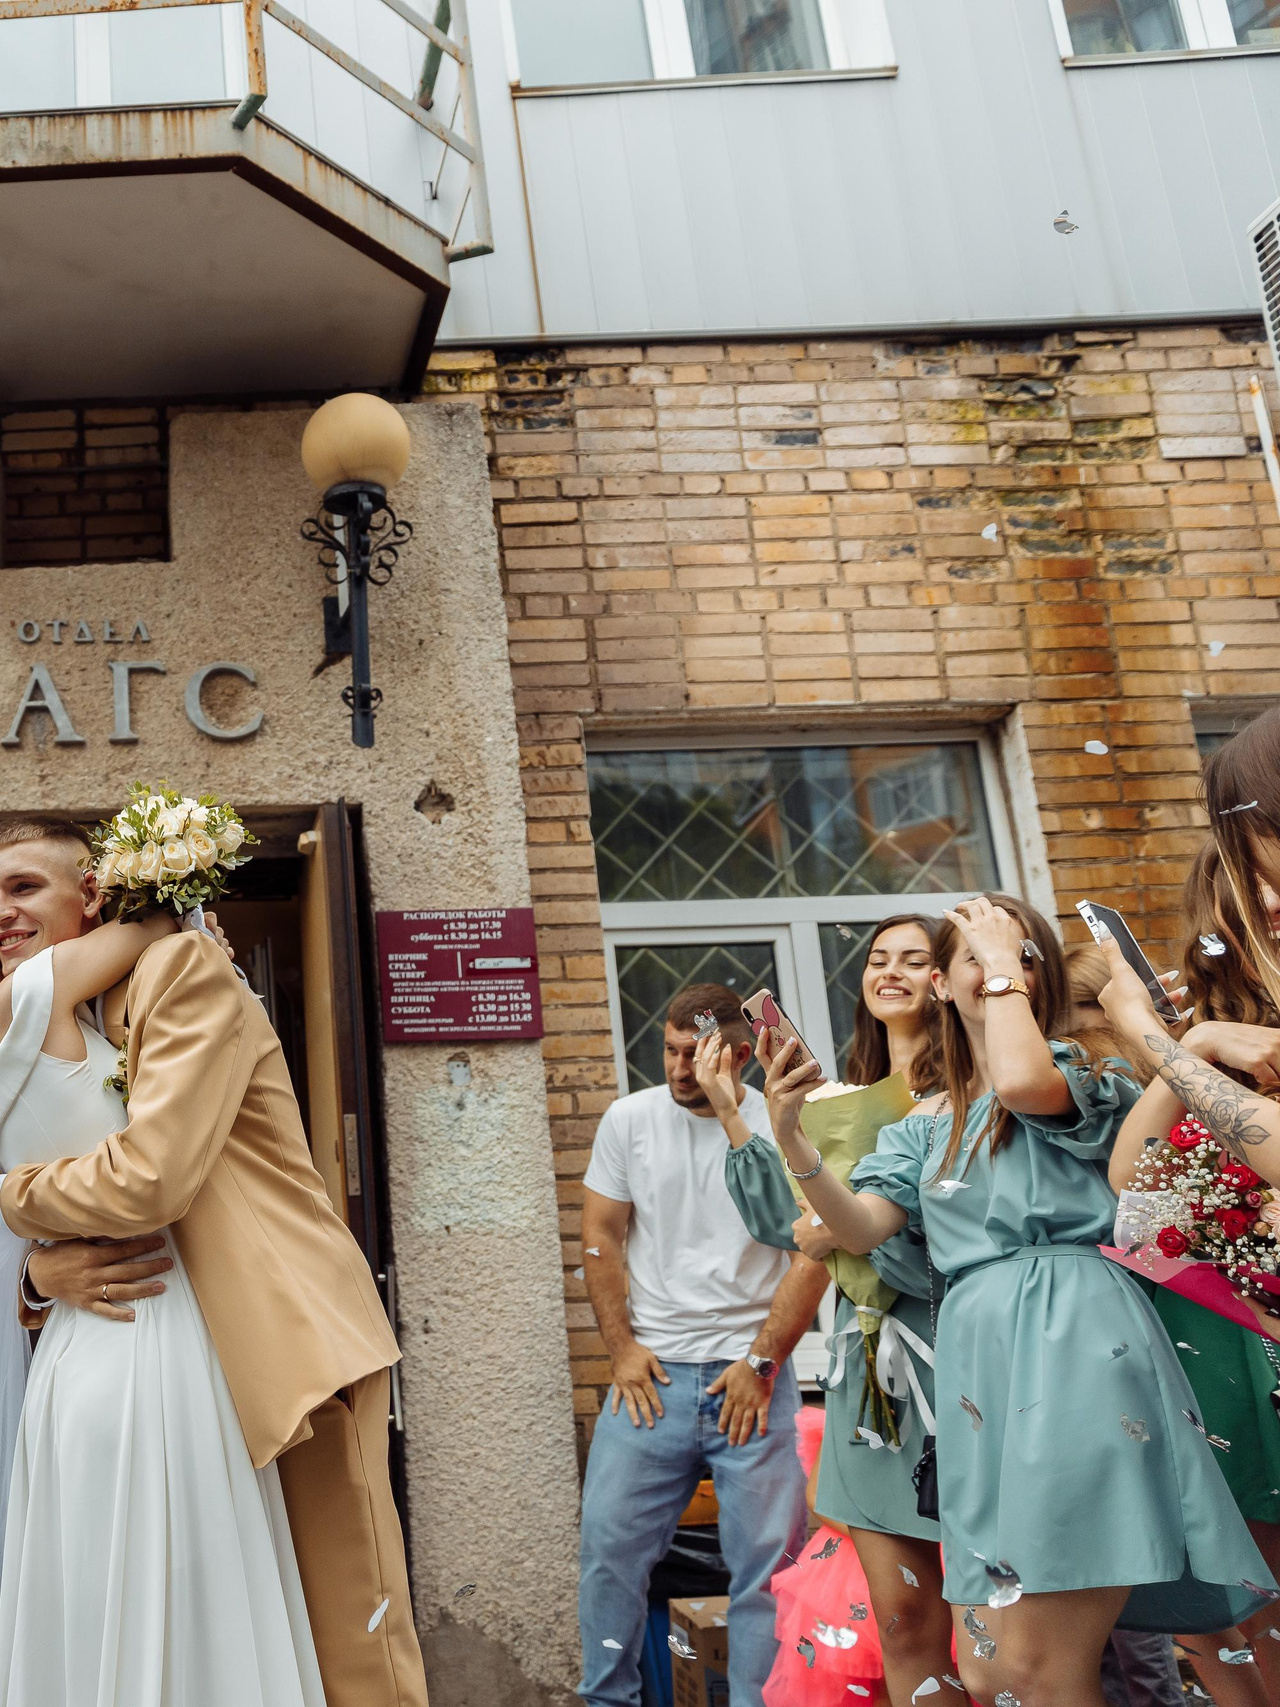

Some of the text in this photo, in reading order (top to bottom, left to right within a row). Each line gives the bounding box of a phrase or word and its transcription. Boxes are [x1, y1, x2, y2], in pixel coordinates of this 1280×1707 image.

[17, 619, 151, 644] ОТДЕЛ
[403, 910, 506, 920] РАСПОРЯДОК РАБОТЫ
[449, 921, 467, 930] 8.30
[468, 922, 479, 930] до
[480, 920, 502, 929] 17.30
[410, 932, 444, 943] суббота
[450, 931, 468, 940] 8.30
[468, 932, 480, 940] до
[481, 930, 502, 940] 16.15
[388, 952, 428, 961] ВТОРНИК
[388, 962, 417, 970] СРЕДА
[389, 971, 427, 979] ЧЕТВЕРГ
[390, 995, 435, 1003] ПЯТНИЦА
[477, 993, 496, 1002] 8.30
[496, 994, 507, 1002] до
[509, 992, 531, 1001] 16.30
[391, 1006, 431, 1014] СУББОТА
[478, 1003, 496, 1012] 8.30
[498, 1015, 509, 1023] до
[510, 1013, 533, 1022] 13.45
